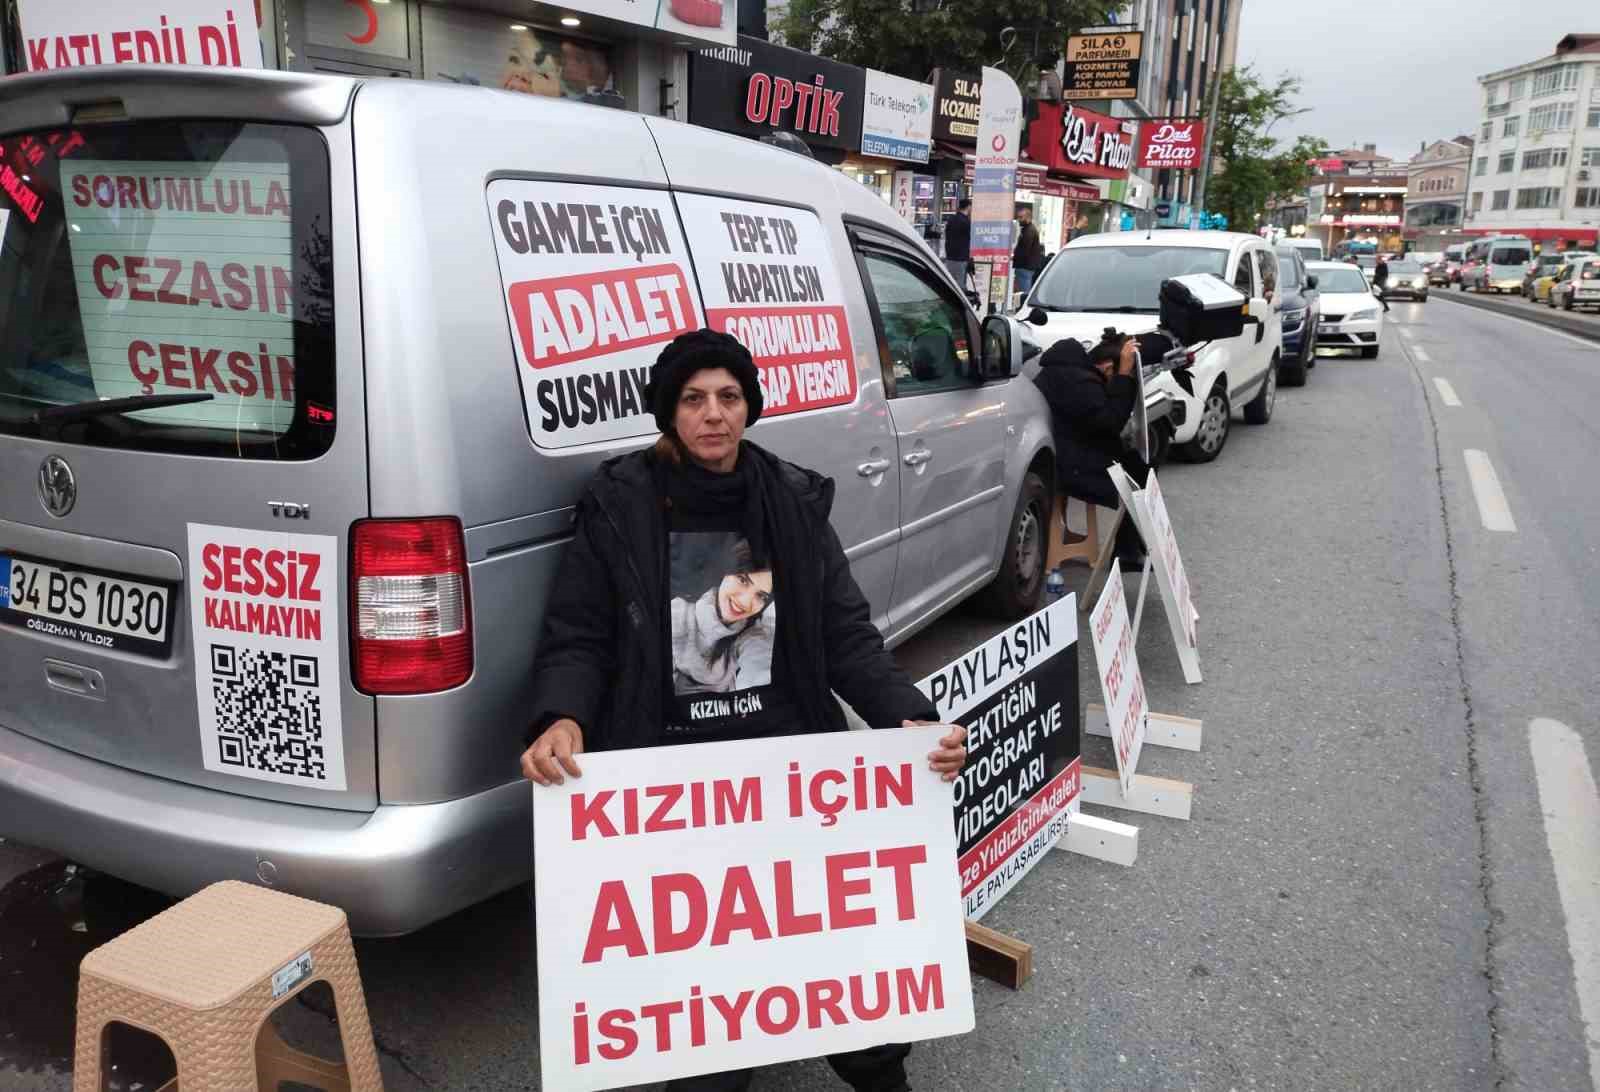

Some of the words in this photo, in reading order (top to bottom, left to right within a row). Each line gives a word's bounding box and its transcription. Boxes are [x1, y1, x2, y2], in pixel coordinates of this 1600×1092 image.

[745, 72, 844, 137] OPTİK
[870, 91, 887, 107] Türk
[888, 96, 917, 113] Telekom
[1144, 144, 1197, 160] Pilav
[498, 199, 613, 254] GAMZE
[608, 204, 671, 262] İÇİN
[720, 212, 774, 254] TEPE
[767, 217, 798, 255] TIP
[721, 262, 824, 303] KAPATILSIN
[528, 274, 688, 359] ADALET
[725, 314, 841, 357] SORUMLULAR
[792, 359, 851, 403] VERSİN
[202, 543, 321, 601] SESSİZ
[11, 565, 41, 610] 34
[48, 571, 88, 619] BS
[97, 581, 165, 635] 1030
[204, 597, 321, 640] KALMAYIN
[27, 618, 78, 640] OĞUZHAN
[80, 631, 114, 648] YILDIZ
[930, 611, 1050, 710] PAYLAŞIN
[690, 700, 731, 720] KIZIM
[734, 692, 762, 718] İÇİN
[963, 681, 1036, 753] EKTİĞİN
[1040, 702, 1061, 738] VE
[570, 776, 764, 841] KIZIM
[787, 756, 914, 827] İÇİN
[581, 844, 928, 964] ADALET
[966, 888, 984, 917] İLE
[573, 963, 945, 1066] İSTİYORUM
